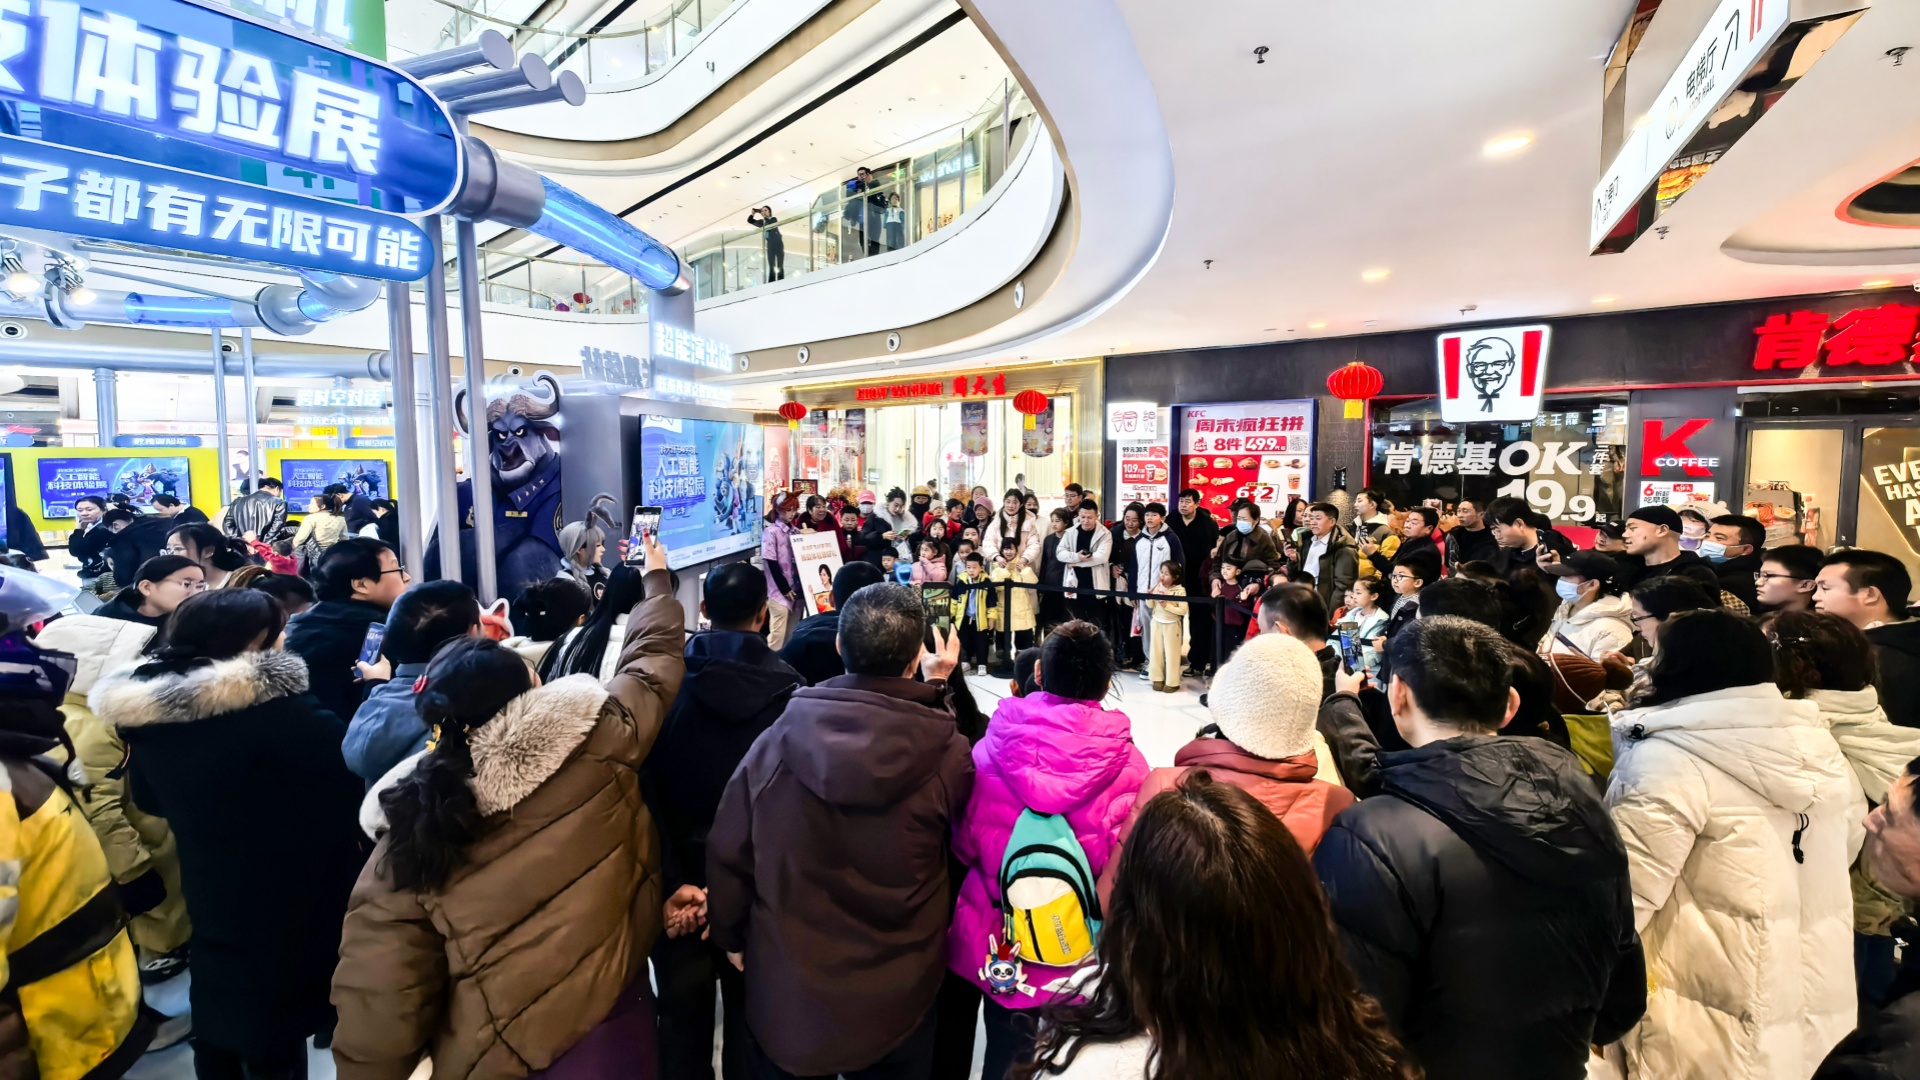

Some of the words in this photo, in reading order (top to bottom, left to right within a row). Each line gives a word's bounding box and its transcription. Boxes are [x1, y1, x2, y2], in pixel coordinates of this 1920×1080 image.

[1686, 36, 1718, 98] 电梯厅
[0, 155, 422, 272] 子都有无限可能
[654, 321, 733, 373] 超能演出站
[1753, 302, 1920, 371] 肯德
[855, 386, 888, 400] CHOW
[891, 385, 909, 398] TAI
[911, 382, 943, 396] SENG
[952, 372, 1006, 397] 周大生
[1187, 410, 1206, 418] KFC
[1195, 416, 1304, 433] 周末疯狂拼
[1214, 438, 1242, 451] 8件
[1641, 418, 1714, 477] K
[656, 456, 700, 477] 人工智能
[1384, 441, 1497, 475] 肯德基
[1499, 440, 1588, 476] OK
[1589, 441, 1609, 475] 三件套
[1655, 457, 1719, 467] COFFEE
[47, 480, 108, 490] 科技体验展
[54, 473, 100, 481] 人工智能
[648, 476, 706, 500] 科技体验展
[1497, 479, 1596, 522] 19.9
